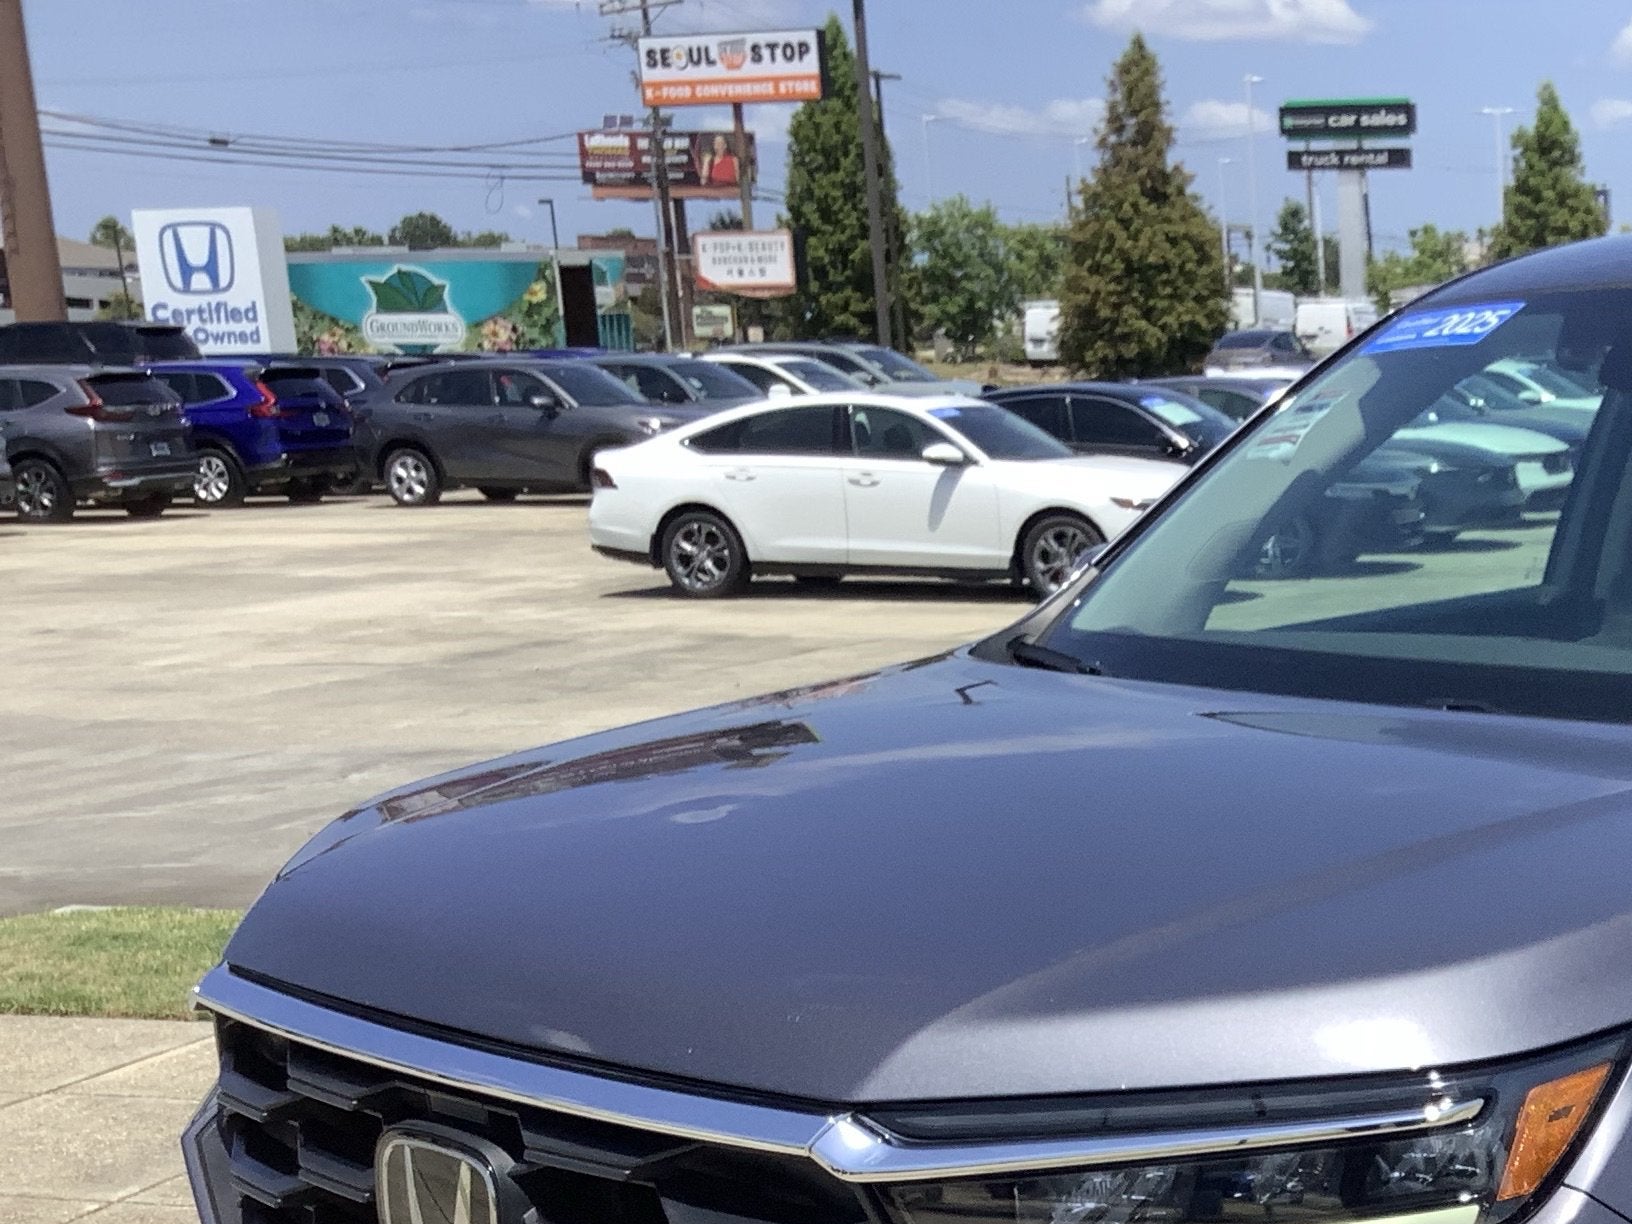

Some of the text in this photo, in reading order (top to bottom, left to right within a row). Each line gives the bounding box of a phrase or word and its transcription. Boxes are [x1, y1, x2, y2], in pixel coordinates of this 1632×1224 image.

[646, 41, 810, 70] SEOUL STOP
[645, 79, 818, 101] K-FOOD CONVENIENCE STORE
[1327, 113, 1357, 128] car
[1359, 109, 1408, 127] sales
[1300, 150, 1389, 168] truck rental
[151, 300, 259, 324] Certified
[1421, 309, 1512, 338] 2025
[192, 326, 261, 345] Owned
